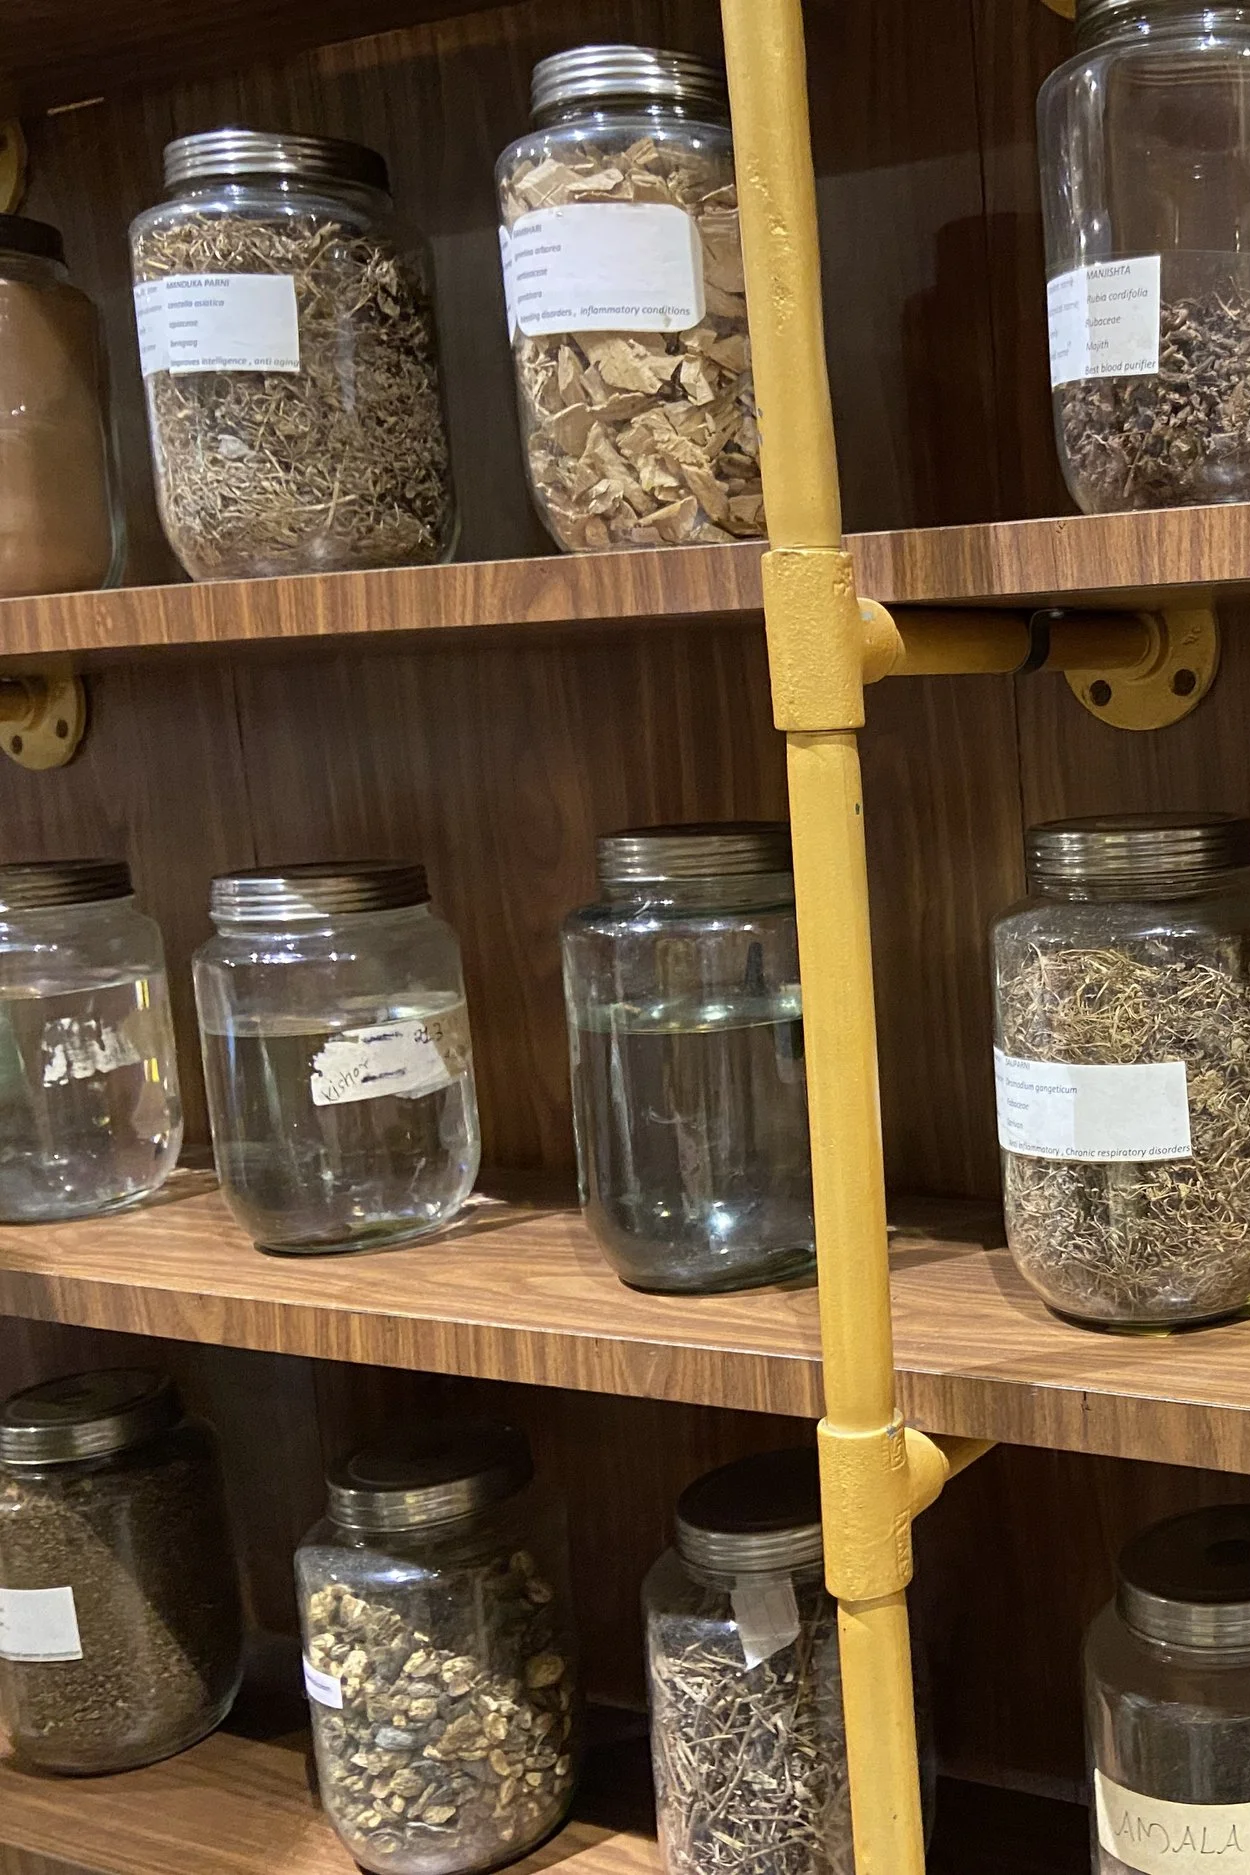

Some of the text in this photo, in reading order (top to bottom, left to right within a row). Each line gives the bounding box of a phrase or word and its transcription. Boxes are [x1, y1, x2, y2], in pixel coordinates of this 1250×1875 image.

[204, 279, 229, 288] PARNI
[1108, 288, 1148, 301] cordifolia
[580, 305, 640, 317] inflammatory
[642, 305, 691, 316] conditions
[254, 358, 272, 366] anti
[274, 358, 299, 367] aging
[1101, 362, 1122, 373] blood
[1124, 359, 1156, 372] purifier
[1035, 1085, 1078, 1095] gangeticum
[1066, 1147, 1095, 1157] Chronic
[1097, 1148, 1145, 1159] respiratory
[1149, 1145, 1190, 1155] disorders
